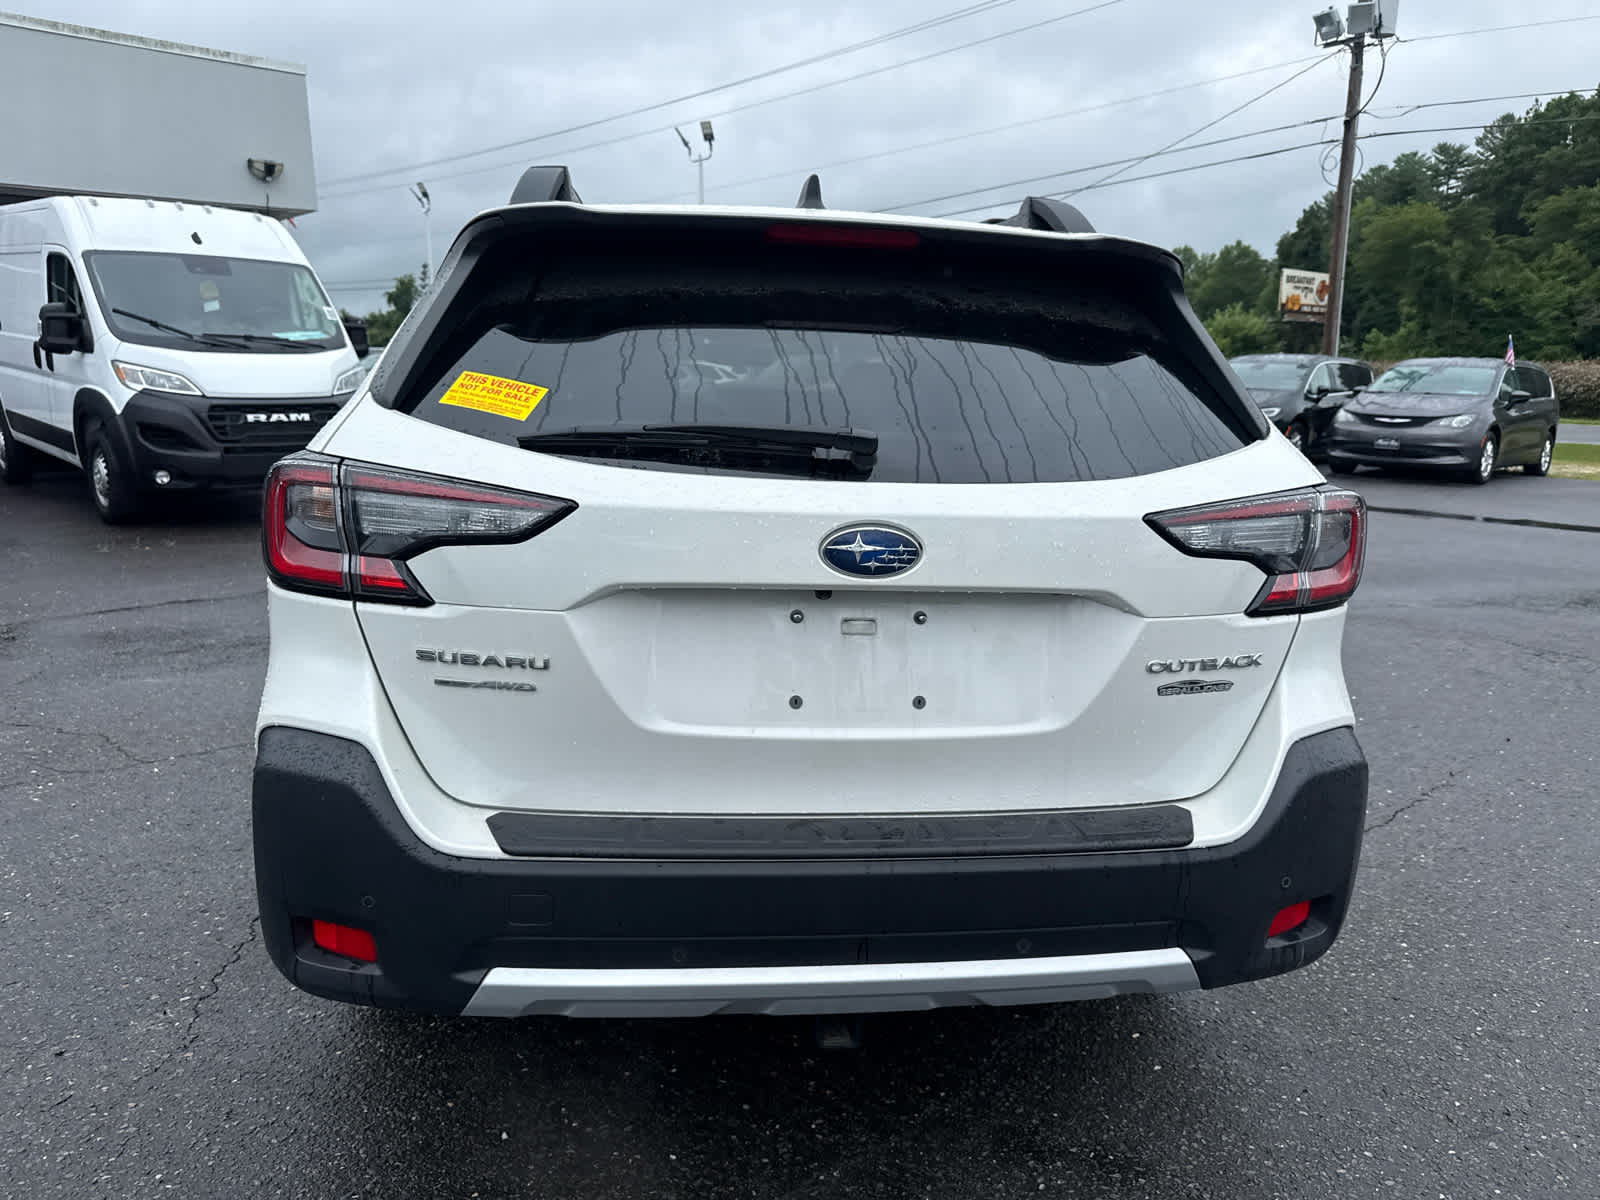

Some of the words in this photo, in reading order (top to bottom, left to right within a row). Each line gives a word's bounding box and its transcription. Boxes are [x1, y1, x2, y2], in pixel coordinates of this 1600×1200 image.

[459, 382, 480, 392] NOT
[480, 386, 502, 397] FOR
[504, 391, 532, 403] SALE
[462, 373, 488, 385] THIS
[490, 379, 542, 397] VEHICLE
[245, 412, 312, 423] RAM
[415, 649, 550, 671] SUBARU
[1146, 652, 1263, 674] OUTBACK
